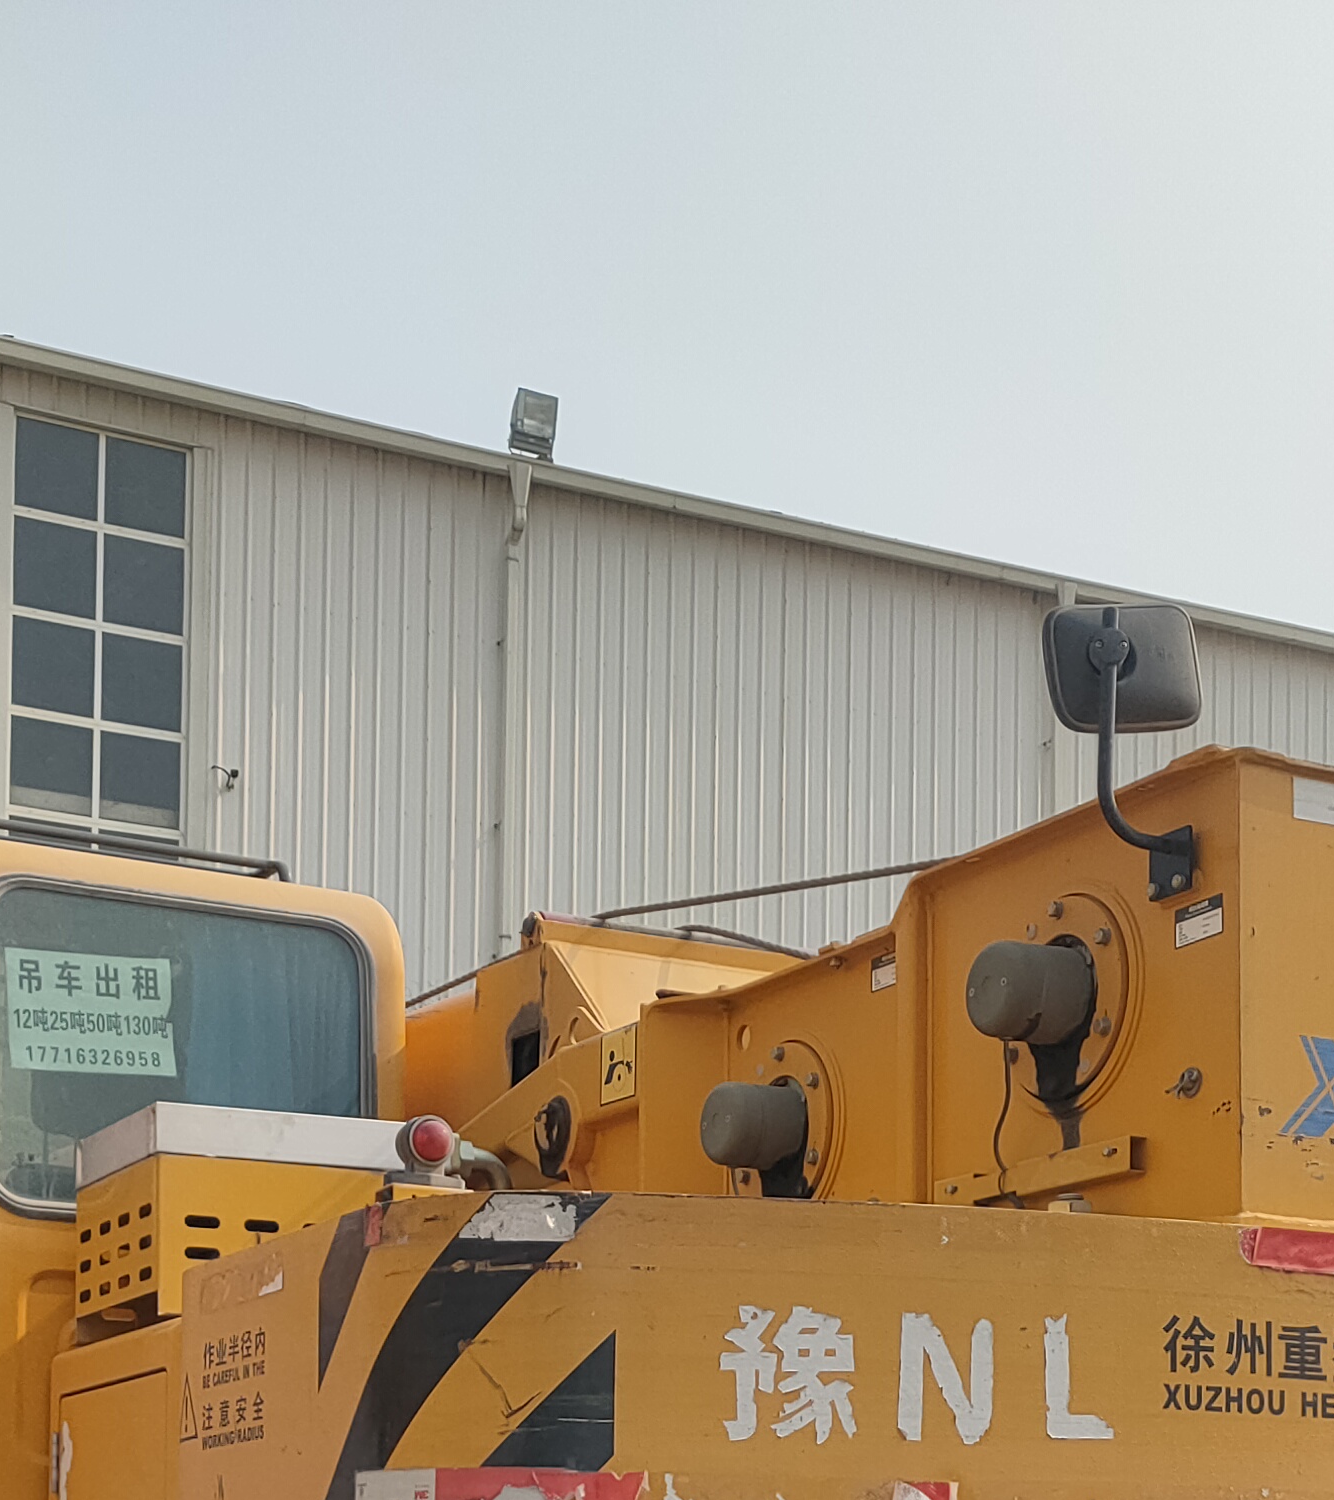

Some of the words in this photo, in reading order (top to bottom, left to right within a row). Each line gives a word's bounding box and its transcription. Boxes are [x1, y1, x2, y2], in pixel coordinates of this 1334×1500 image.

[17, 957, 162, 1002] 吊车出租
[12, 1006, 170, 1040] 12吨25吨50吨130吨
[25, 1045, 162, 1069] 17716326958
[203, 1326, 266, 1370] 作业半径内
[202, 1373, 211, 1389] BE
[212, 1365, 241, 1387] CAREFUL
[242, 1363, 250, 1380] IN
[252, 1359, 266, 1377] THE
[202, 1390, 265, 1431] 注意安全
[1162, 1382, 1287, 1417] XUZHOU
[202, 1430, 236, 1451] WORKING
[237, 1424, 265, 1445] RADIUS
